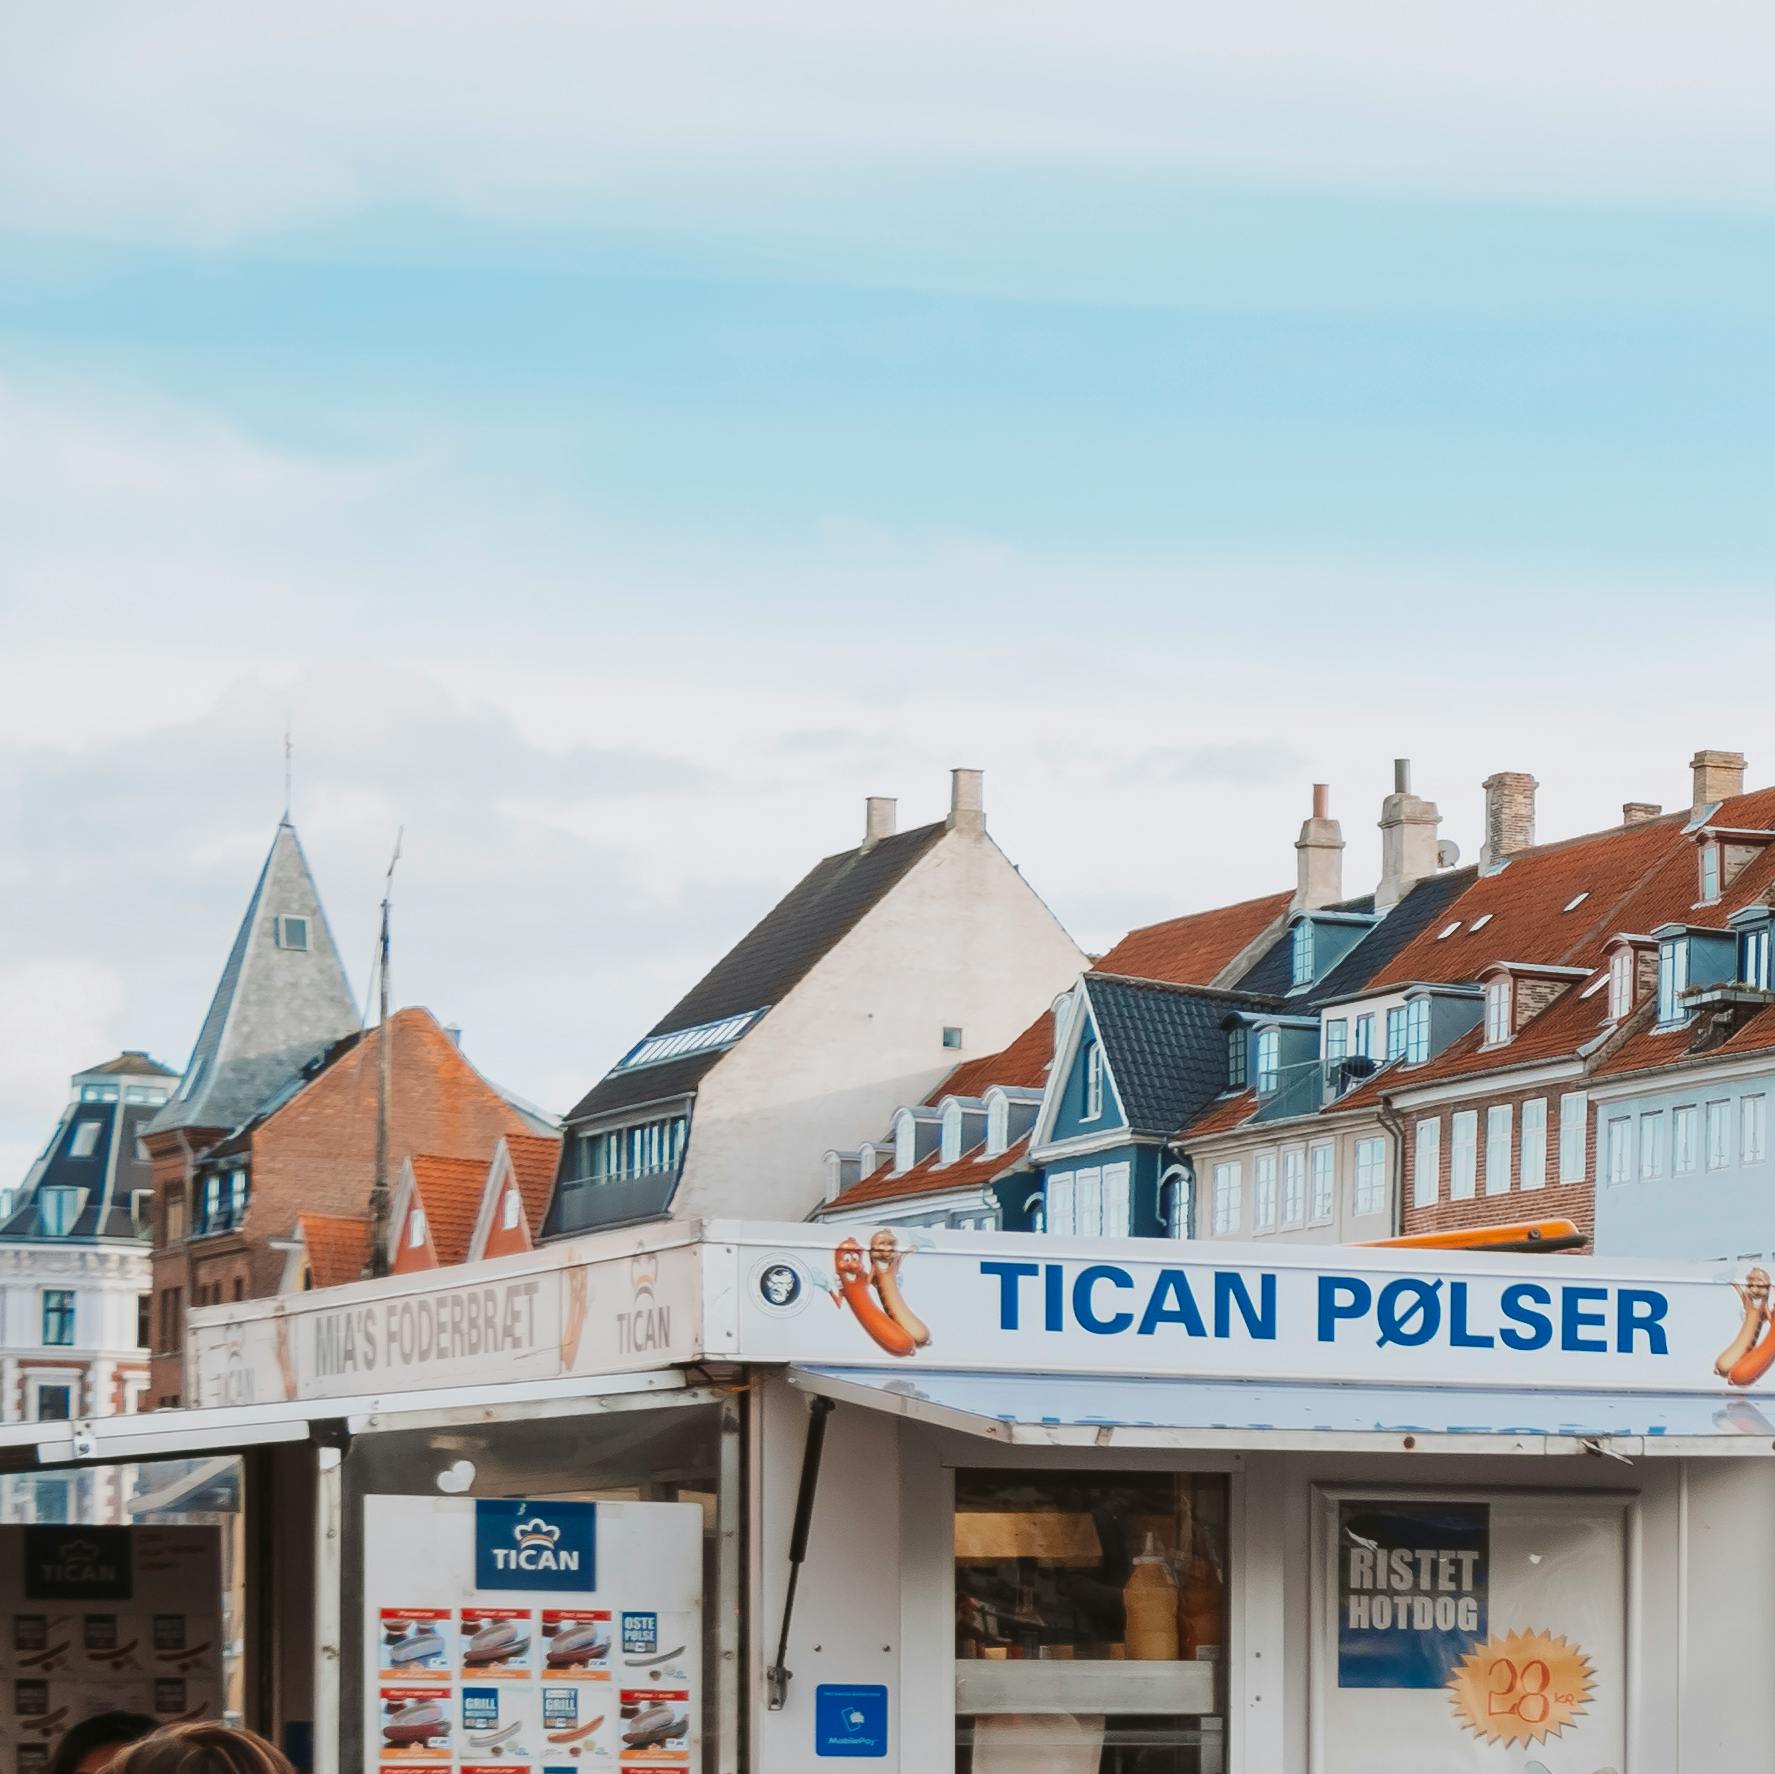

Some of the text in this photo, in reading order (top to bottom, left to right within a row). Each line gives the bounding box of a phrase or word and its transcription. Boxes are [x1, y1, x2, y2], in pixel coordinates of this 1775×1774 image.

[315, 1281, 541, 1378] MIA'S FODERBRÆT
[616, 1305, 671, 1355] TICAN
[980, 1261, 1669, 1355] TICAN PØLSER
[40, 1563, 117, 1583] TICAN
[492, 1549, 580, 1571] TICAN
[1349, 1548, 1480, 1592] RISTET
[1348, 1596, 1479, 1632] HOTDOG
[1488, 1657, 1551, 1724] 28
